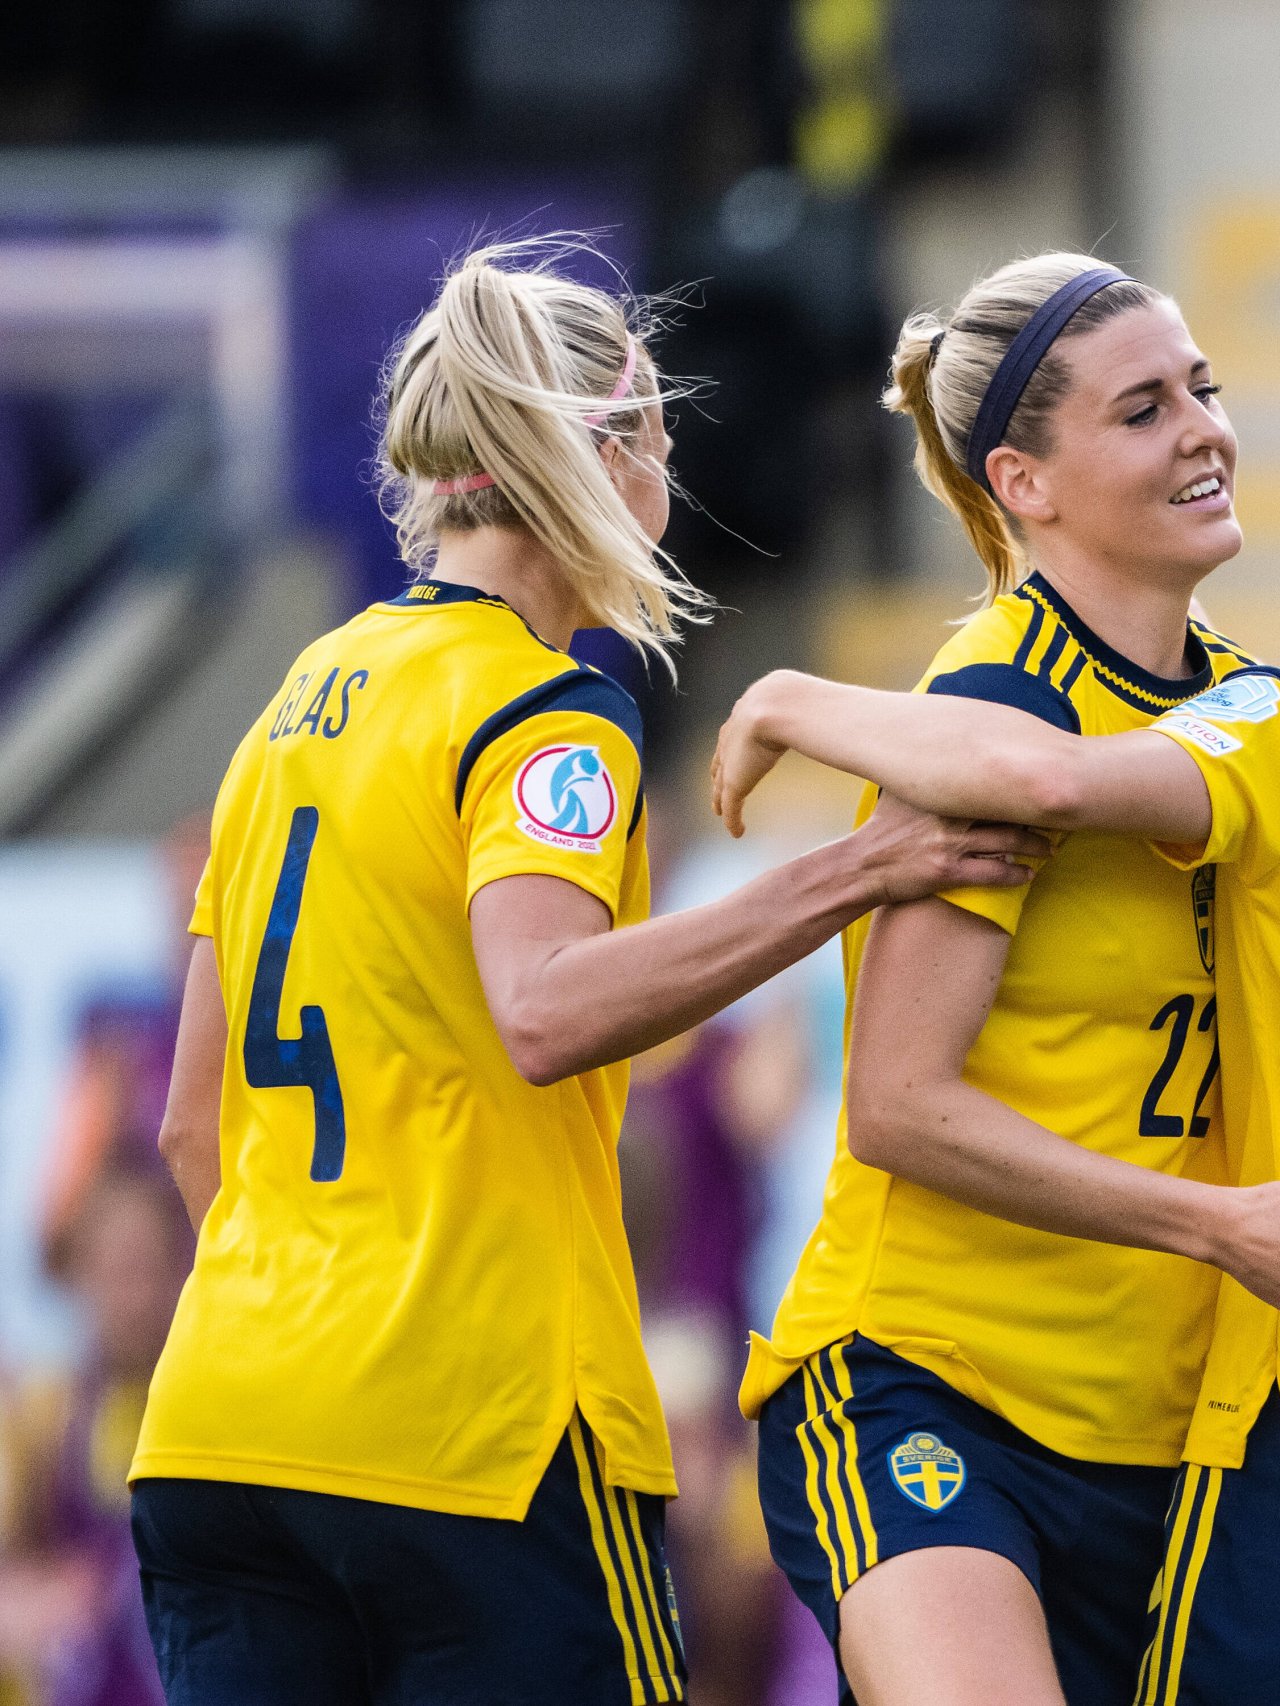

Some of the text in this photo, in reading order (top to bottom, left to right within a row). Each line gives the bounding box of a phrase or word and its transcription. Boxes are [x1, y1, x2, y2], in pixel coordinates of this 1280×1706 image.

[268, 666, 370, 742] GLAS
[525, 823, 574, 847] ENGLAND
[243, 805, 347, 1183] 4
[1138, 993, 1221, 1139] 22
